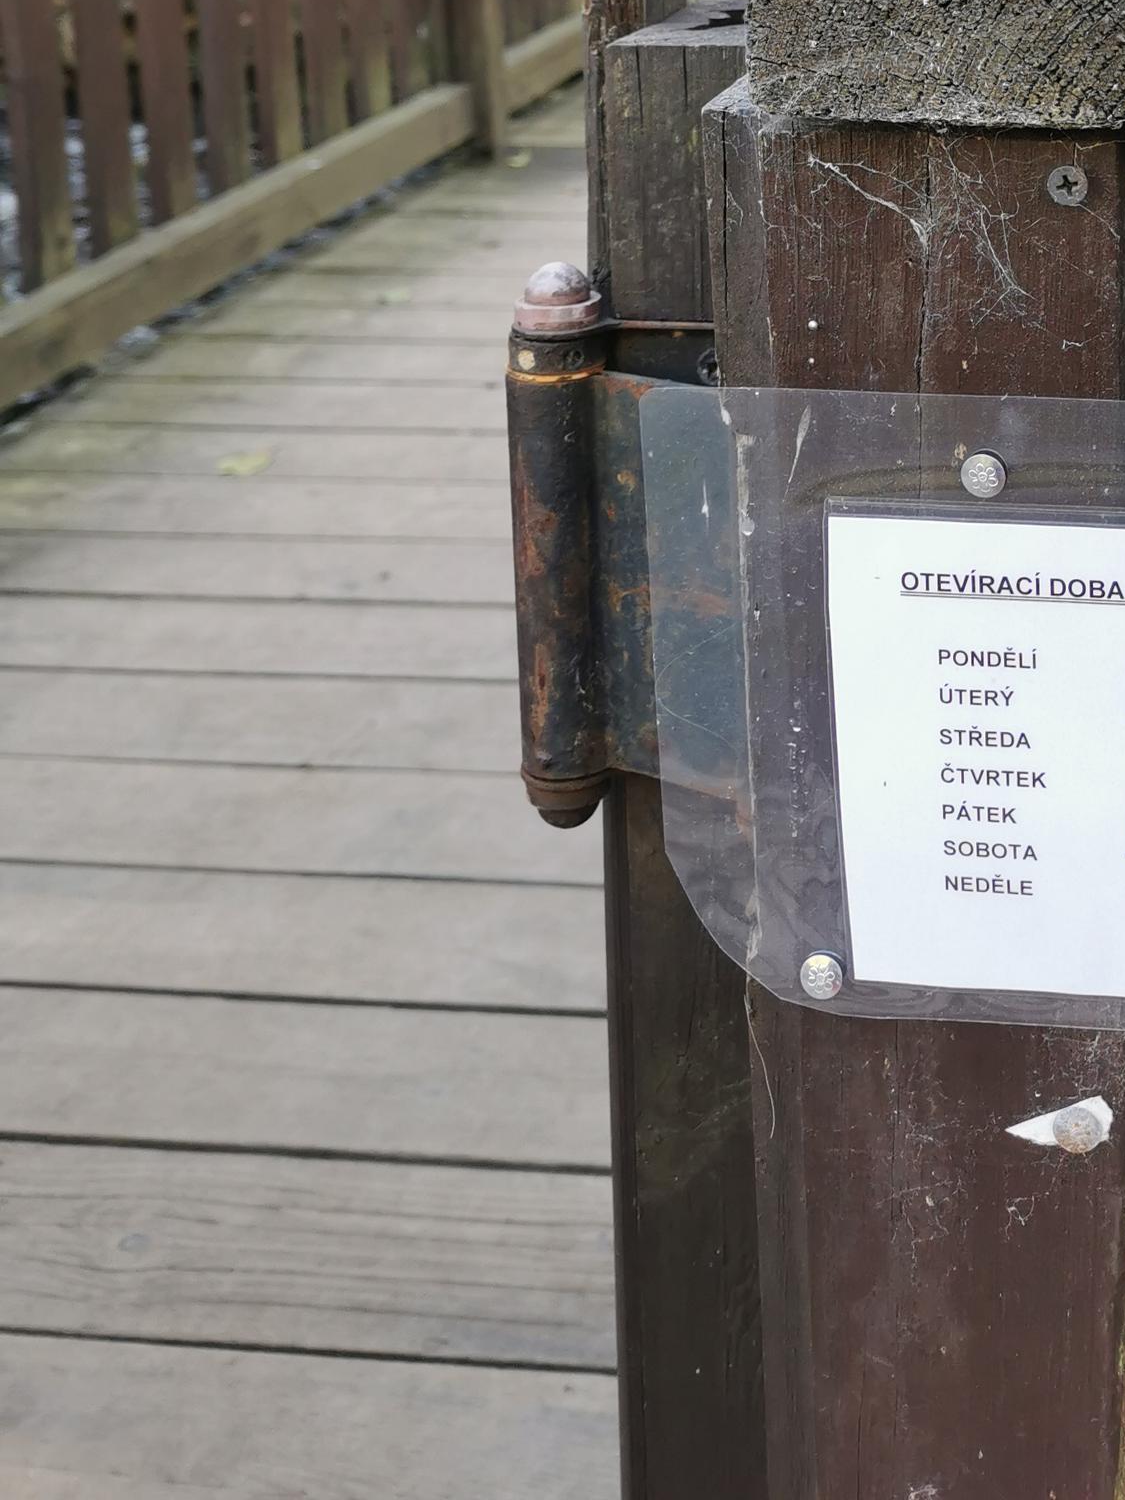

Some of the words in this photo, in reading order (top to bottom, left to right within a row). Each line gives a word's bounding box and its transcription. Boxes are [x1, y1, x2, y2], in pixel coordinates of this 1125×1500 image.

[899, 570, 1041, 597] OTEVÍRACÍ
[1048, 578, 1125, 601] DOBA
[938, 646, 1037, 670] PONDĚLÍ
[939, 683, 1015, 707] ÚTERÝ
[939, 725, 1032, 750] STŘEDA
[940, 762, 1047, 789] ČTVRTEK
[942, 800, 1017, 825] PÁTEK
[943, 839, 1038, 861] SOBOTA
[944, 874, 1034, 897] NEDĚLE
